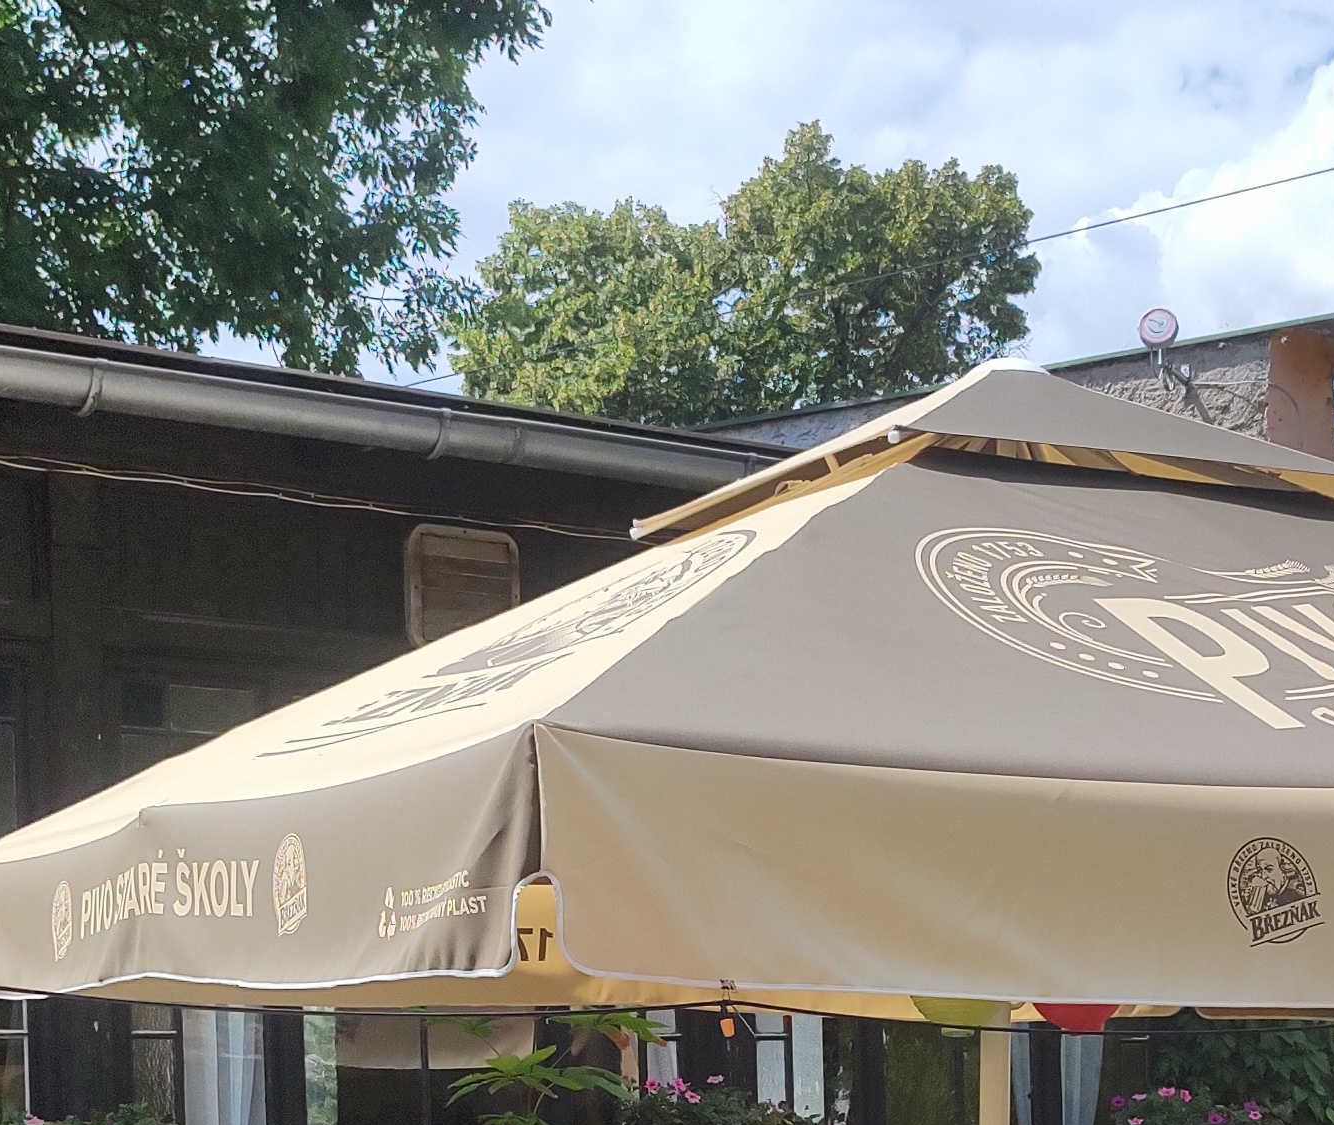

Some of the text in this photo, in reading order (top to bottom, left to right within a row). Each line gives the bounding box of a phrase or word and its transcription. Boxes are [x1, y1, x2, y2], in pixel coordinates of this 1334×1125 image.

[945, 541, 1045, 623] ZALOŽENO 1753
[80, 879, 114, 939] PIVO
[114, 849, 168, 925] STARÉ
[173, 849, 260, 917] ŠKOLY
[447, 895, 487, 917] PLAST
[1250, 900, 1321, 941] BŘEZŇÁK
